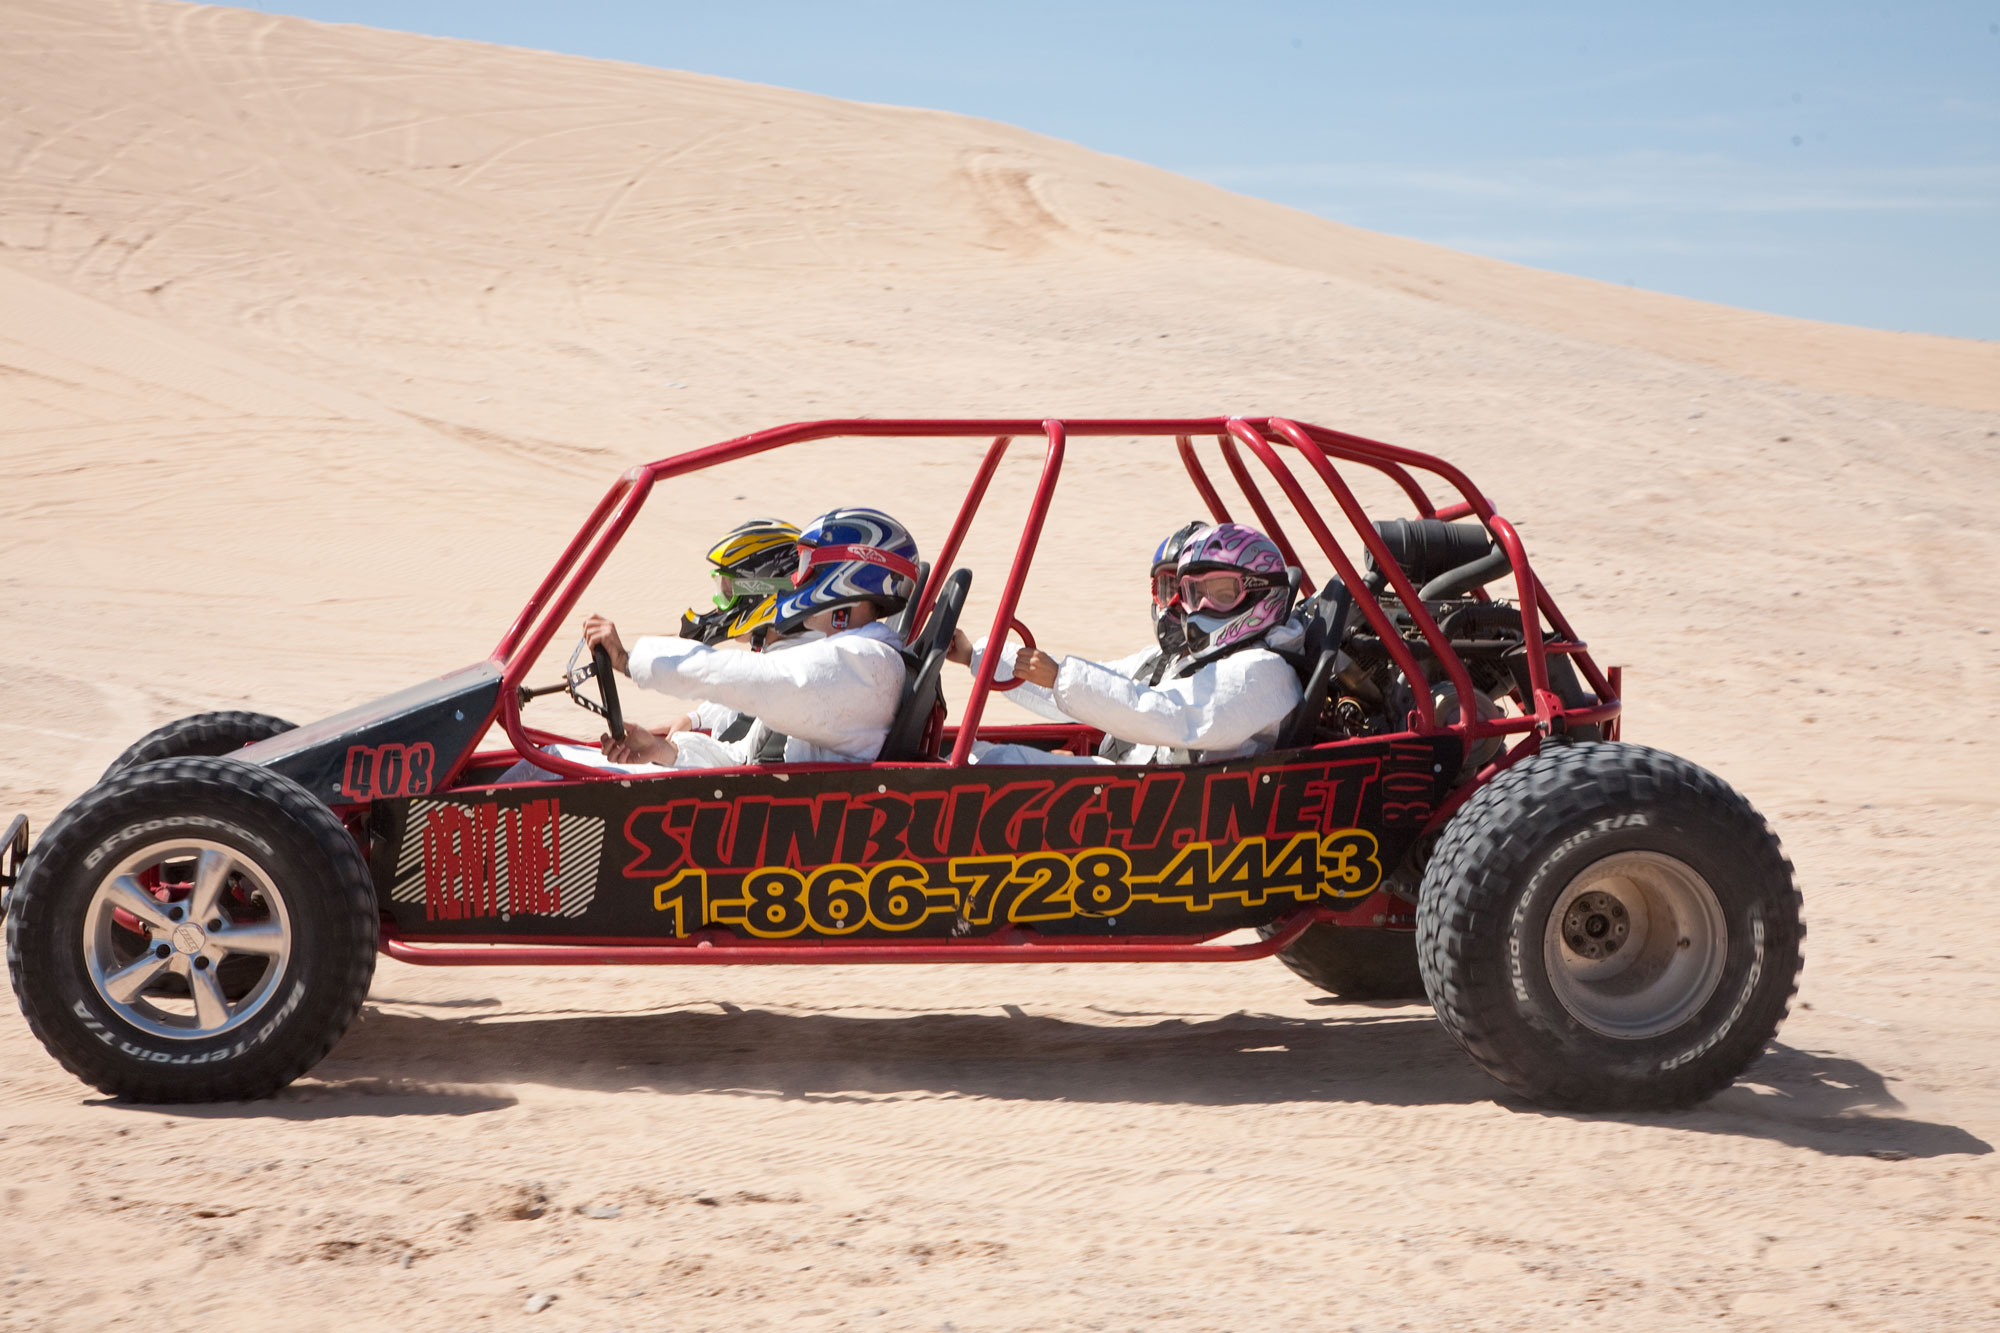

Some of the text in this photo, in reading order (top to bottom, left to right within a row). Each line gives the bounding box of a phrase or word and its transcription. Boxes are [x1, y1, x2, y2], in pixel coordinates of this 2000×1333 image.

[342, 742, 434, 802] 408
[622, 757, 1381, 878] SUNBUGGY.NET
[1594, 812, 1648, 832] T/A
[654, 828, 1382, 938] 1-866-728-4443
